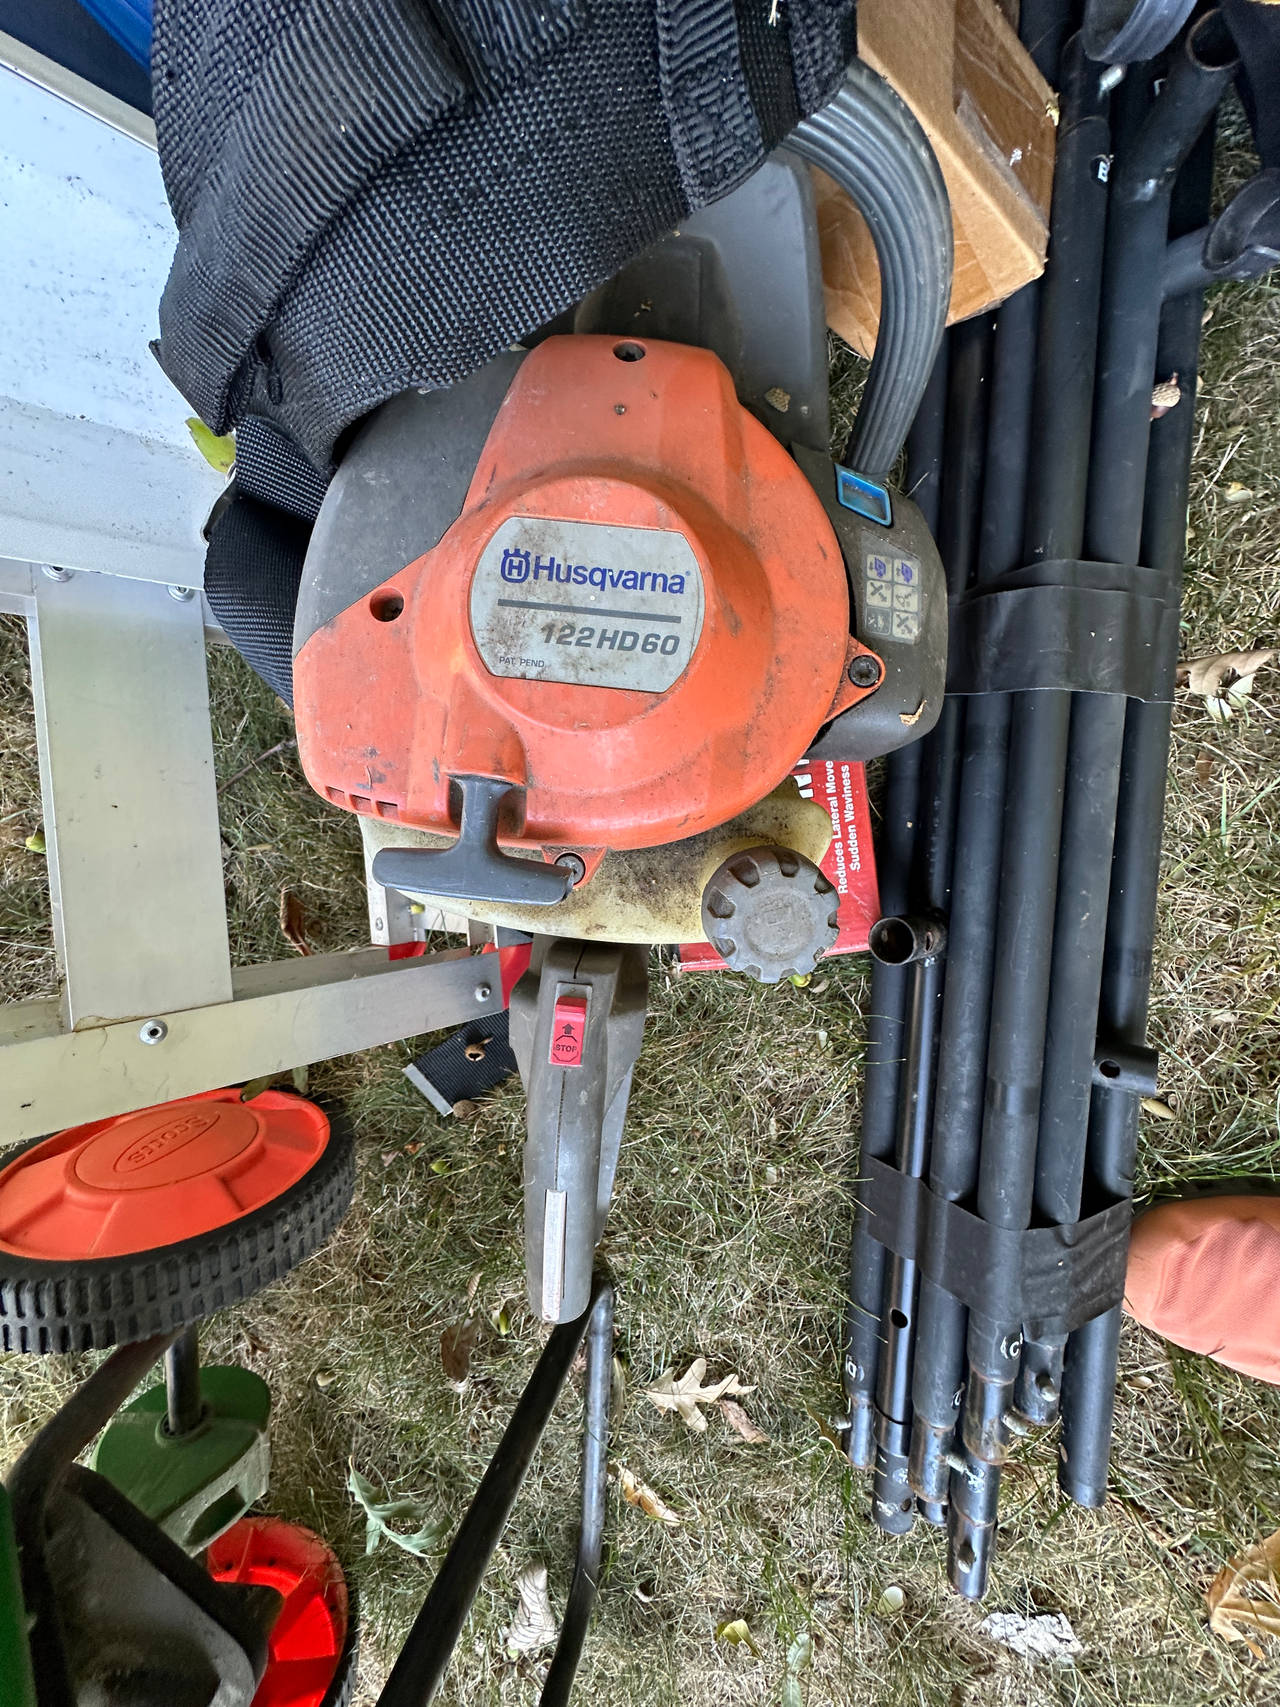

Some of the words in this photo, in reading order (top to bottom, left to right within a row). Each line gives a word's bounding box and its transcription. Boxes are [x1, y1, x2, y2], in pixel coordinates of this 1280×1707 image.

[533, 556, 685, 594] Husqvarna
[541, 623, 680, 656] 122HD60
[841, 764, 855, 823] Waviness
[827, 796, 842, 840] Lateral
[834, 841, 848, 894] Reduces
[847, 825, 861, 871] Sudden
[555, 1044, 577, 1052] STOP
